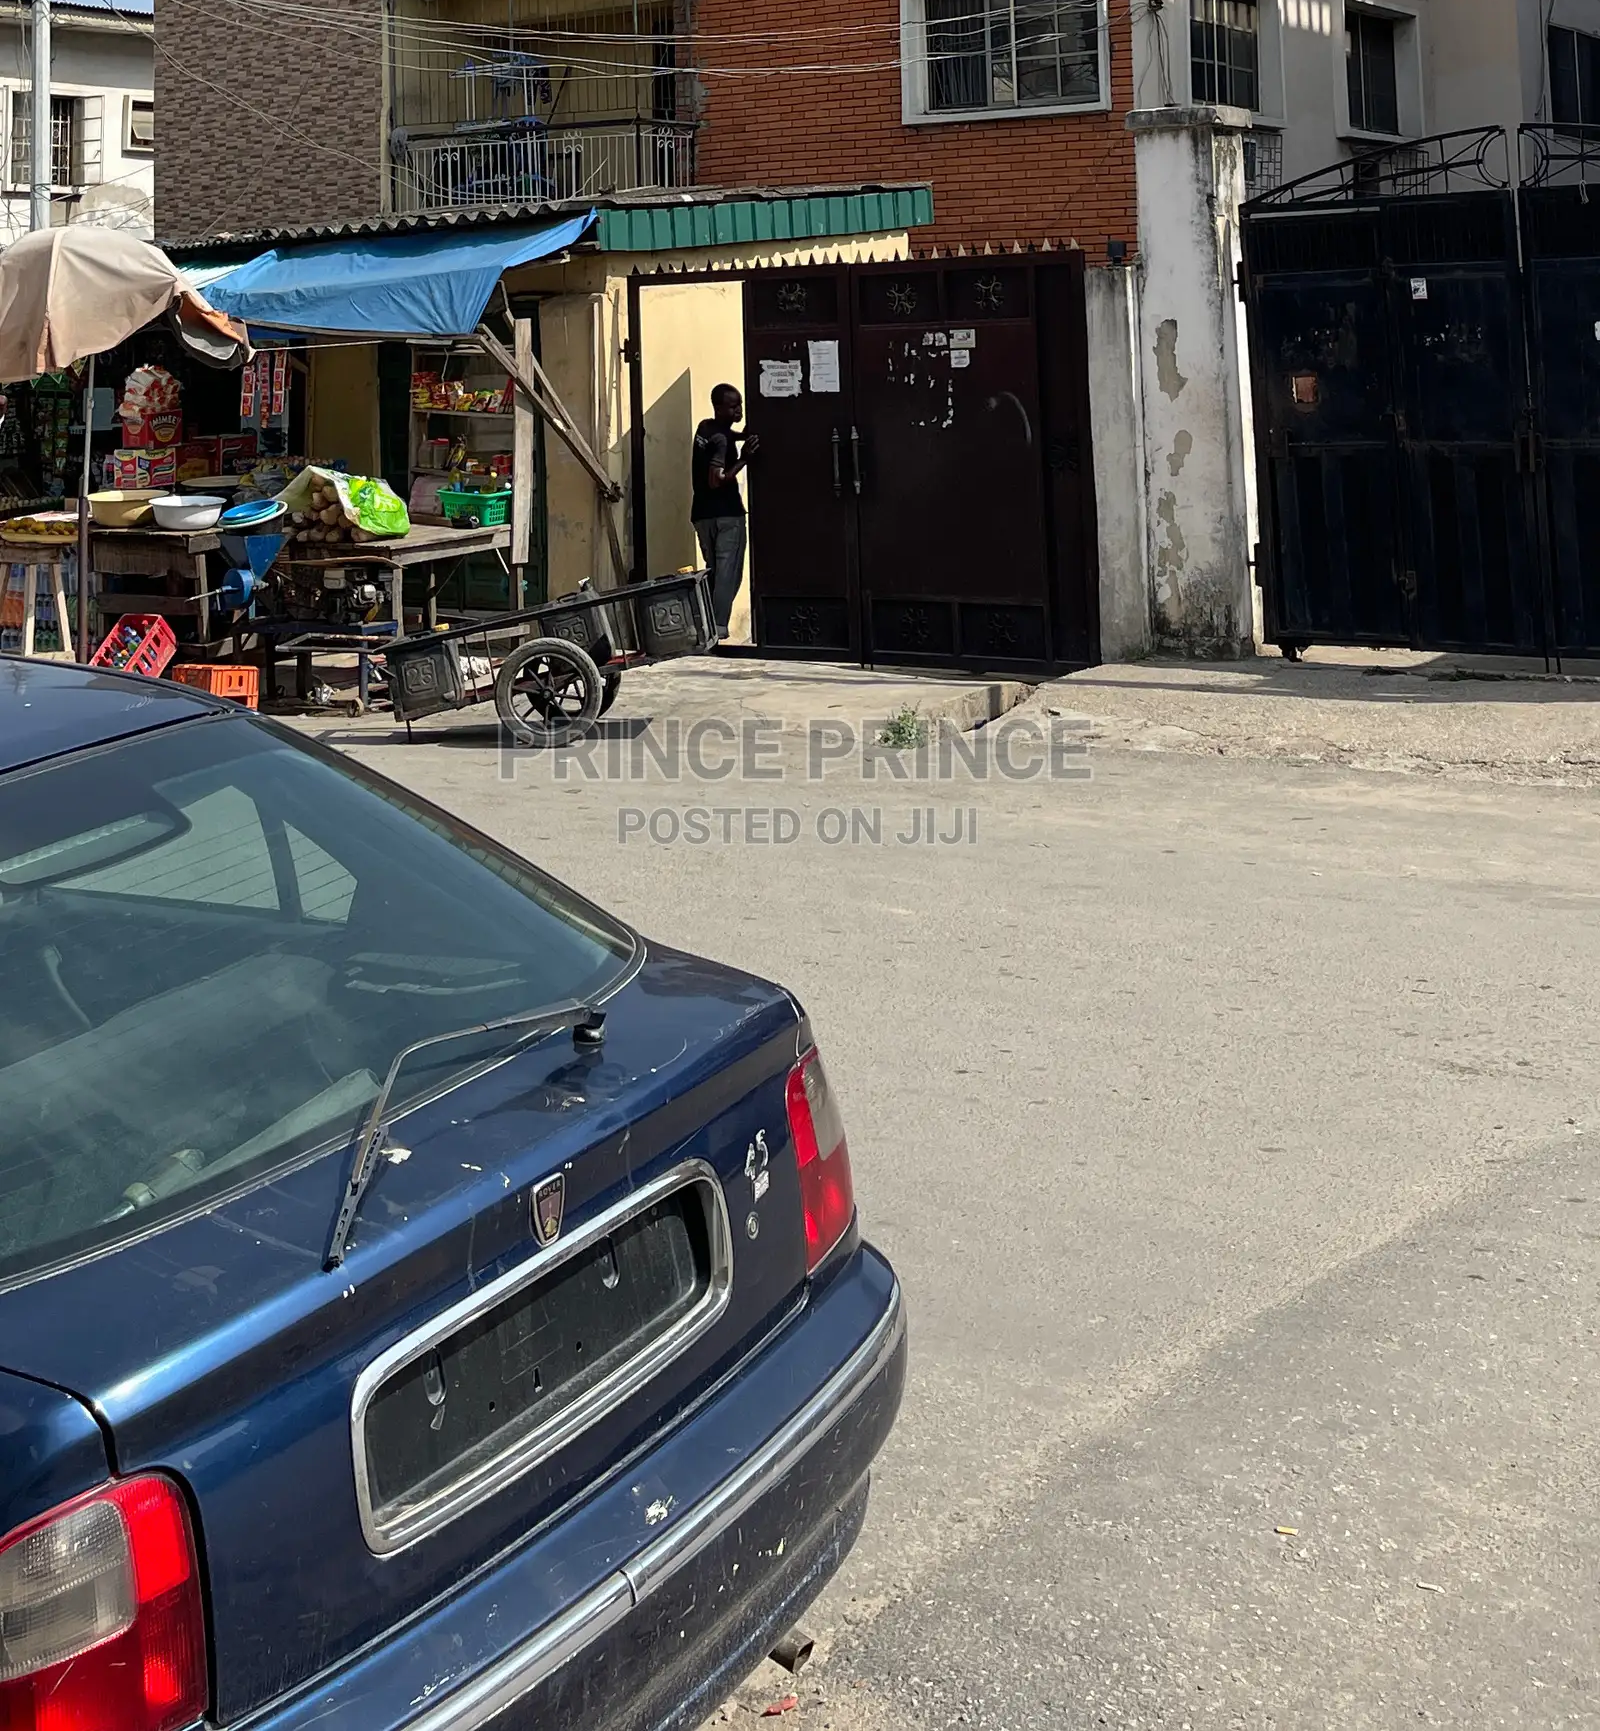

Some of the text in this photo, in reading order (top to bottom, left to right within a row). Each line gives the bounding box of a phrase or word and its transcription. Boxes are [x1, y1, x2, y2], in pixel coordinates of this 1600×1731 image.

[657, 604, 683, 628] 25
[406, 664, 432, 689] 25
[538, 1179, 562, 1197] ROVER
